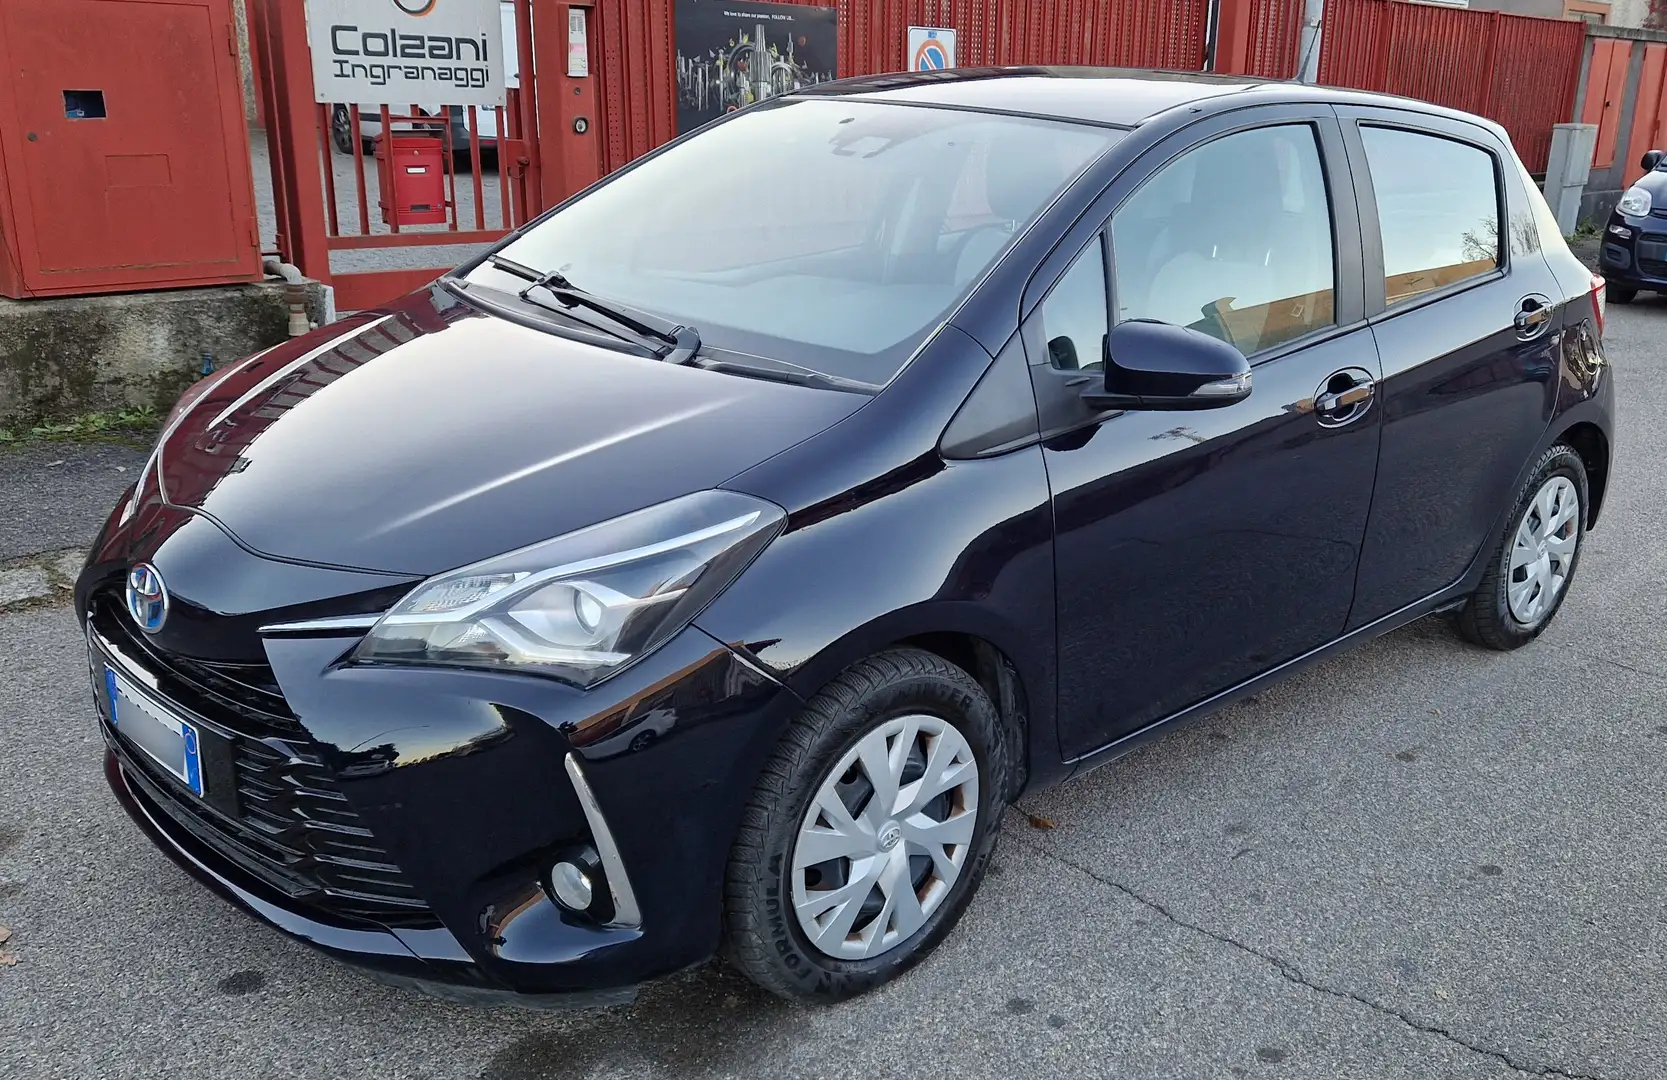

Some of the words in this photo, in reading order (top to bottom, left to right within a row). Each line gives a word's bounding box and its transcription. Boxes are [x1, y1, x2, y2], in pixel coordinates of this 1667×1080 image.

[331, 25, 488, 62] Colzani
[333, 59, 489, 88] Ingranaggi
[765, 853, 813, 981] FORMULA
